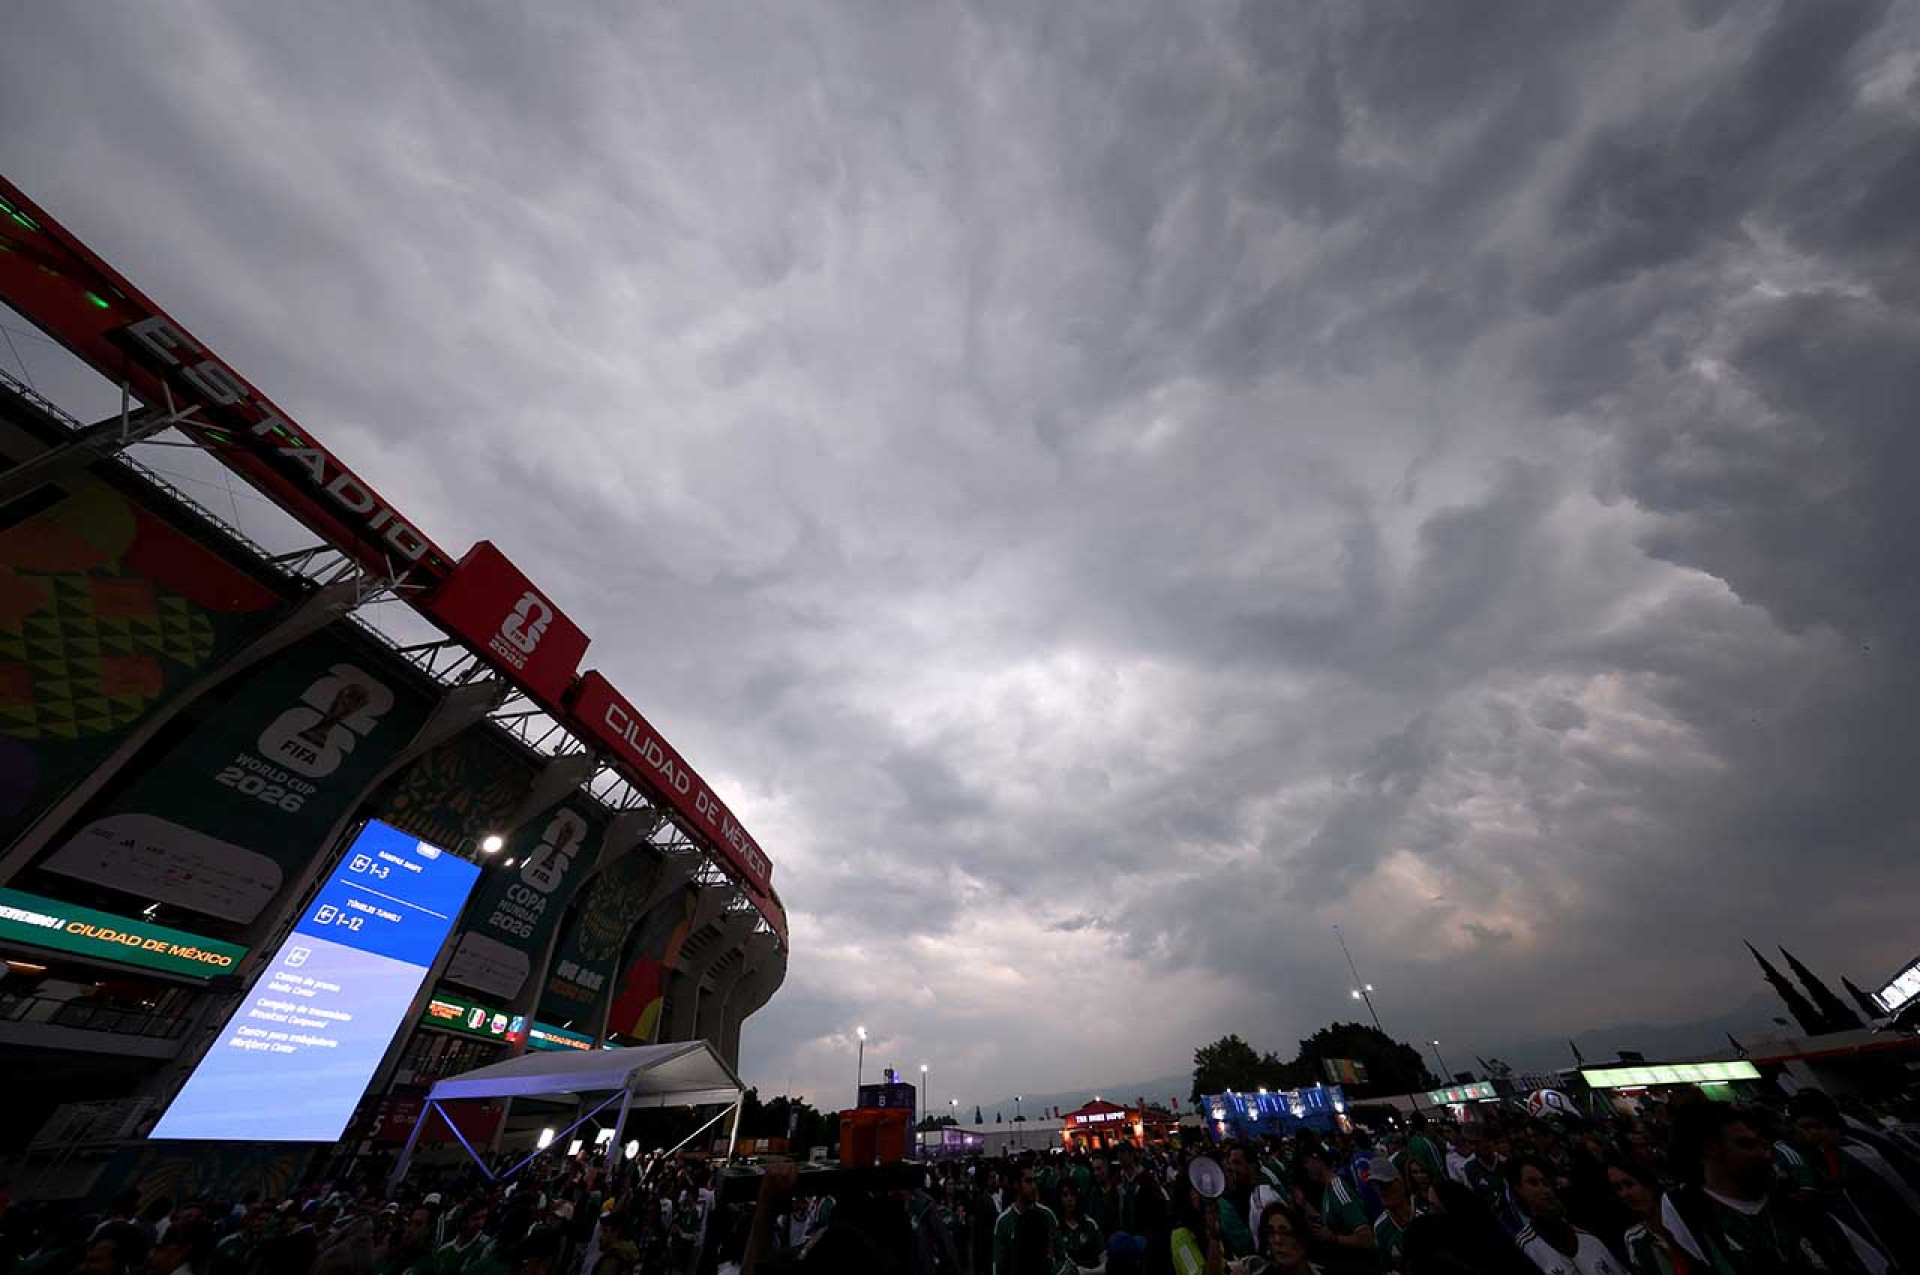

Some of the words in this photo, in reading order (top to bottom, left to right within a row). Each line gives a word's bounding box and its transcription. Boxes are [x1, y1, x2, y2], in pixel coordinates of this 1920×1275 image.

[126, 315, 430, 561] ESTADIO
[488, 638, 524, 670] 2026
[234, 753, 288, 783] WORLD
[287, 774, 318, 794] CUP
[280, 741, 317, 765] FIFA
[215, 766, 306, 813] 2026
[605, 703, 690, 795] CIUDAD
[695, 790, 718, 827] DE
[722, 819, 767, 878] MÉXICO
[506, 883, 547, 914] COPA
[66, 922, 142, 947] CIUDAD
[141, 938, 169, 953] DE
[168, 944, 232, 967] MÉXICO
[488, 911, 534, 938] 2026
